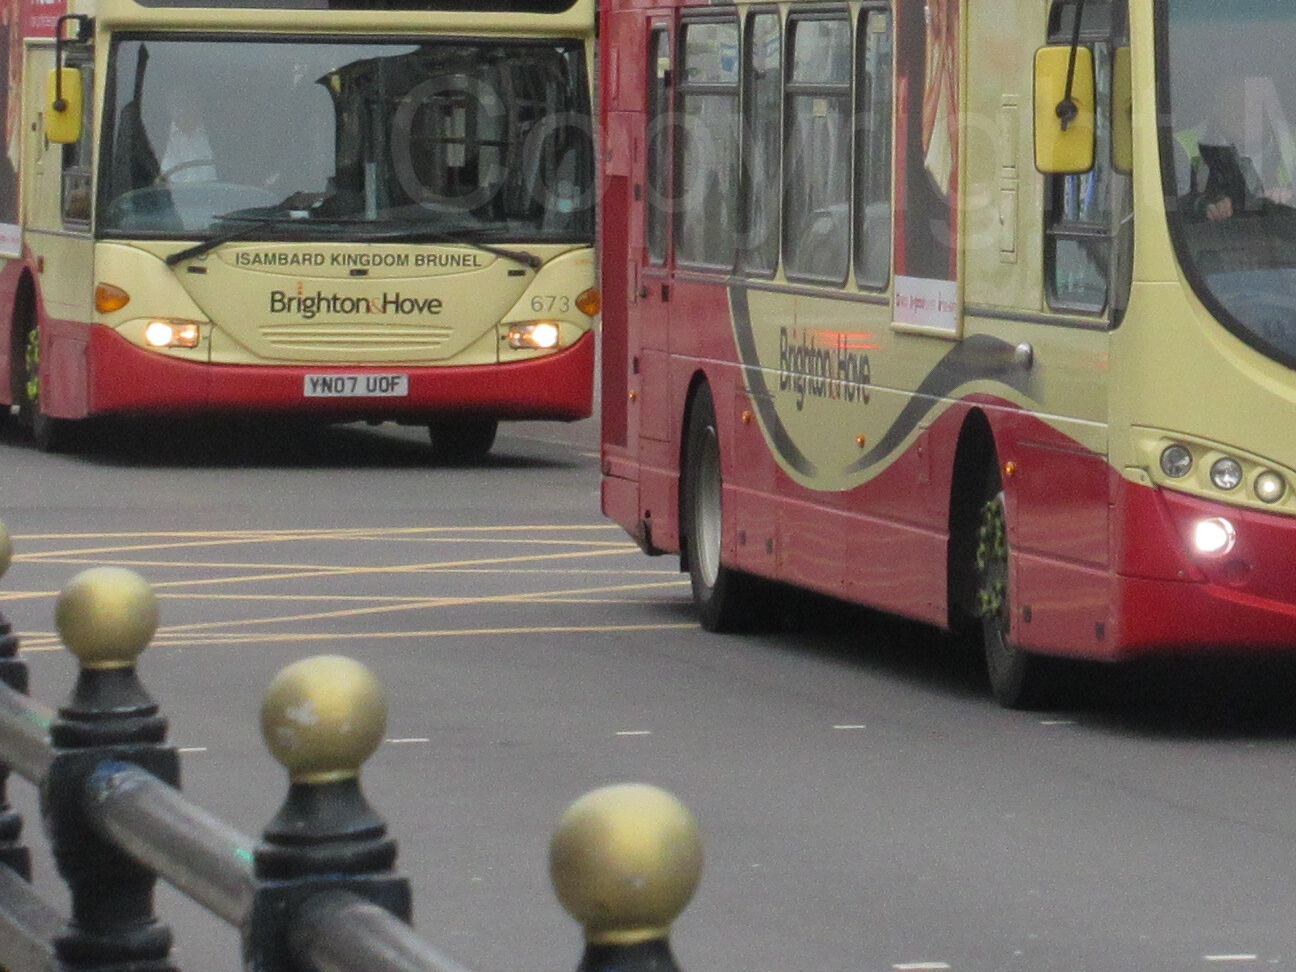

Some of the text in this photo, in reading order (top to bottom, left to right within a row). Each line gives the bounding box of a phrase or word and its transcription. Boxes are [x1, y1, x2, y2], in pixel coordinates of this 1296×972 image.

[236, 252, 482, 268] ISAMBARD KINGDOM BRUNEL
[530, 294, 571, 313] 673
[309, 376, 400, 394] YN07 UOF
